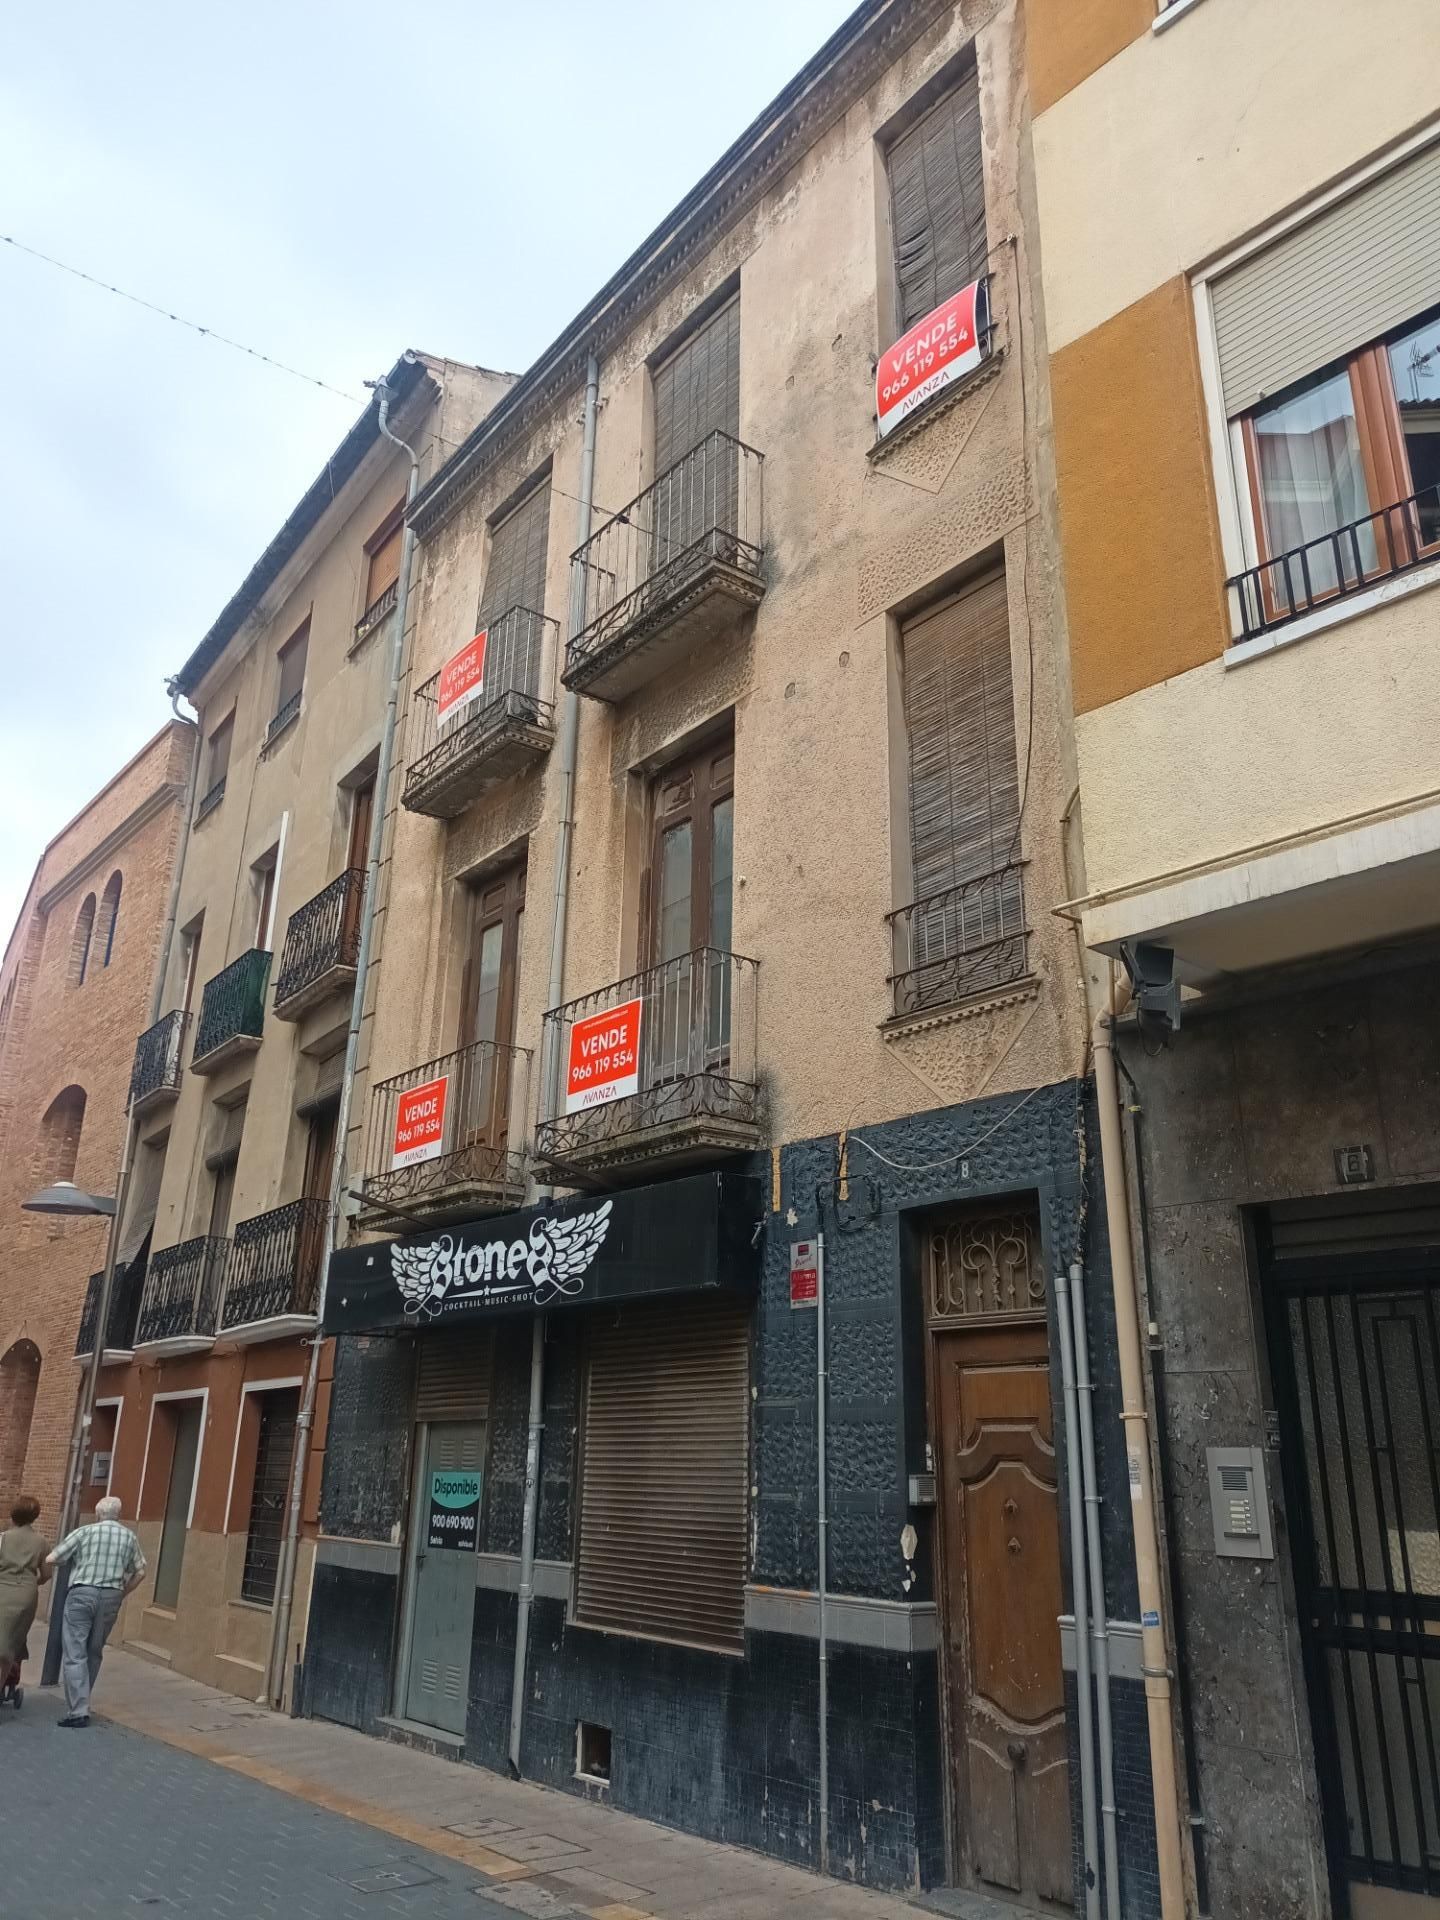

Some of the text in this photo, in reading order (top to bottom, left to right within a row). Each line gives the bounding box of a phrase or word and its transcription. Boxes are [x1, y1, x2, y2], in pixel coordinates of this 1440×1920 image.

[892, 311, 957, 372] VENDE
[882, 327, 968, 401] 966 119 554
[902, 371, 950, 414] AVANZA
[446, 650, 478, 685] VENDE
[581, 1024, 628, 1057] VENDE
[572, 1048, 633, 1082] 966 119 554
[404, 1096, 438, 1124] VENDE
[582, 1085, 617, 1106] AVANZA
[398, 1118, 440, 1143] 966 119 554
[961, 1161, 969, 1178] 8
[428, 1217, 555, 1302] Stones
[434, 1478, 478, 1498] Disponible
[432, 1514, 475, 1530] 900 690 900
